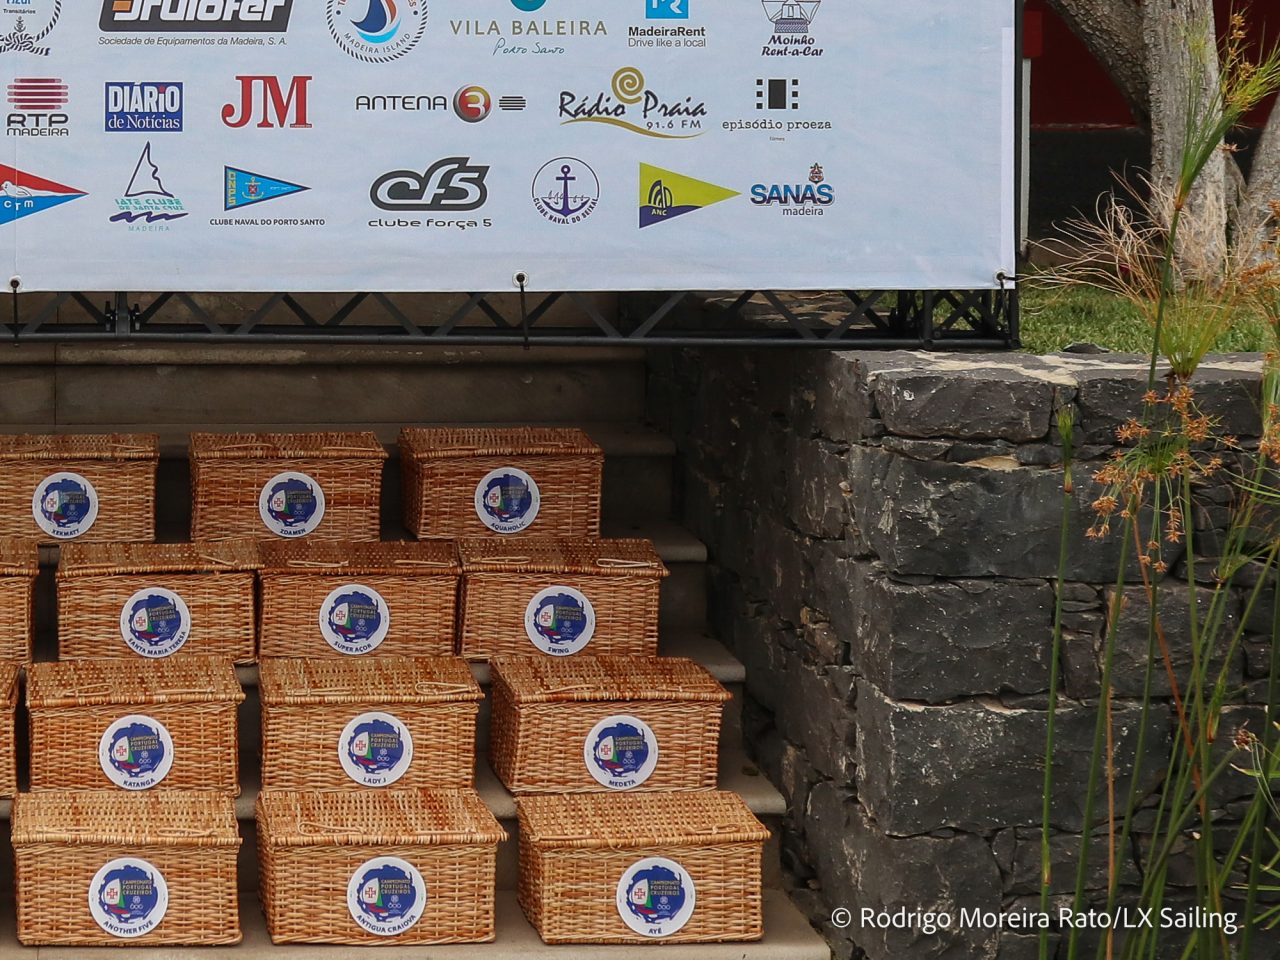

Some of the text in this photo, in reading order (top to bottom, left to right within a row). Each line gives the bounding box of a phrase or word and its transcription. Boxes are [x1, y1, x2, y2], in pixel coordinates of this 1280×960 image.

[450, 20, 608, 36] VILA BALEIRA
[628, 26, 705, 38] MadeiraRent
[628, 38, 652, 47] Drive
[655, 38, 670, 47] like
[684, 38, 706, 47] local
[768, 34, 815, 46] Moinho
[761, 46, 823, 57] Rent-a-Car
[222, 76, 312, 128] JM
[356, 92, 485, 117] ANTENA 3
[559, 91, 707, 118] Rádio Praia
[7, 114, 69, 127] RTP
[108, 115, 180, 129] de Notícias
[646, 120, 702, 130] 91.6 FM
[722, 120, 832, 131] episódio proeza
[7, 128, 69, 136] MADEIRA
[750, 184, 835, 206] SANAS
[782, 206, 824, 216] madeira
[209, 218, 325, 226] CLUBE NAVAL DO PORTO SANTO
[368, 218, 492, 230] clube força 5
[129, 638, 146, 653] SANTA
[147, 647, 168, 655] MARIA
[123, 778, 156, 787] KATANGA
[103, 920, 154, 934] ANOTHER FIVE
[356, 914, 386, 933] ANTIGUA
